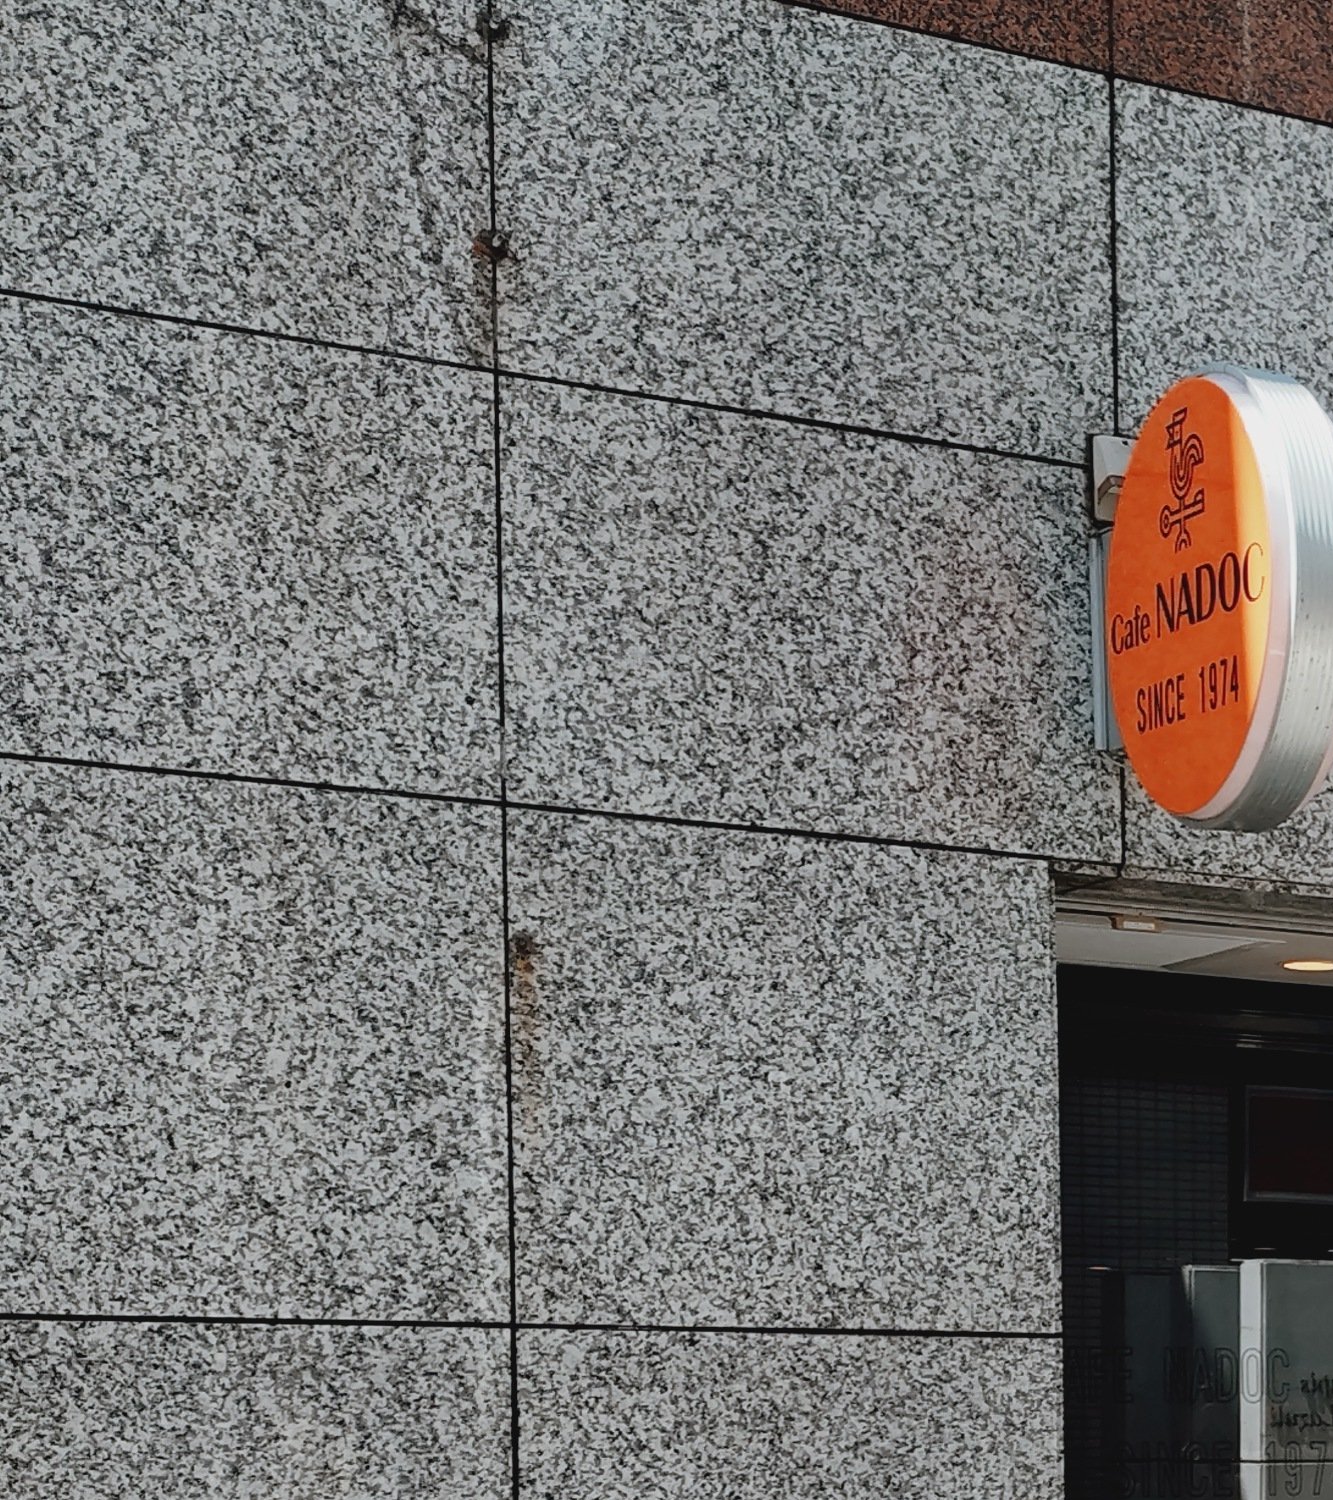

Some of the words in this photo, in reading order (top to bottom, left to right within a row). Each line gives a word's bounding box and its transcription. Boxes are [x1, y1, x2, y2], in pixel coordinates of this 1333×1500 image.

[1110, 605, 1151, 655] Cafe
[1155, 542, 1266, 638] NADOC
[1136, 673, 1186, 735] SINCE
[1199, 655, 1240, 714] 1974
[1164, 1346, 1290, 1404] NADOC
